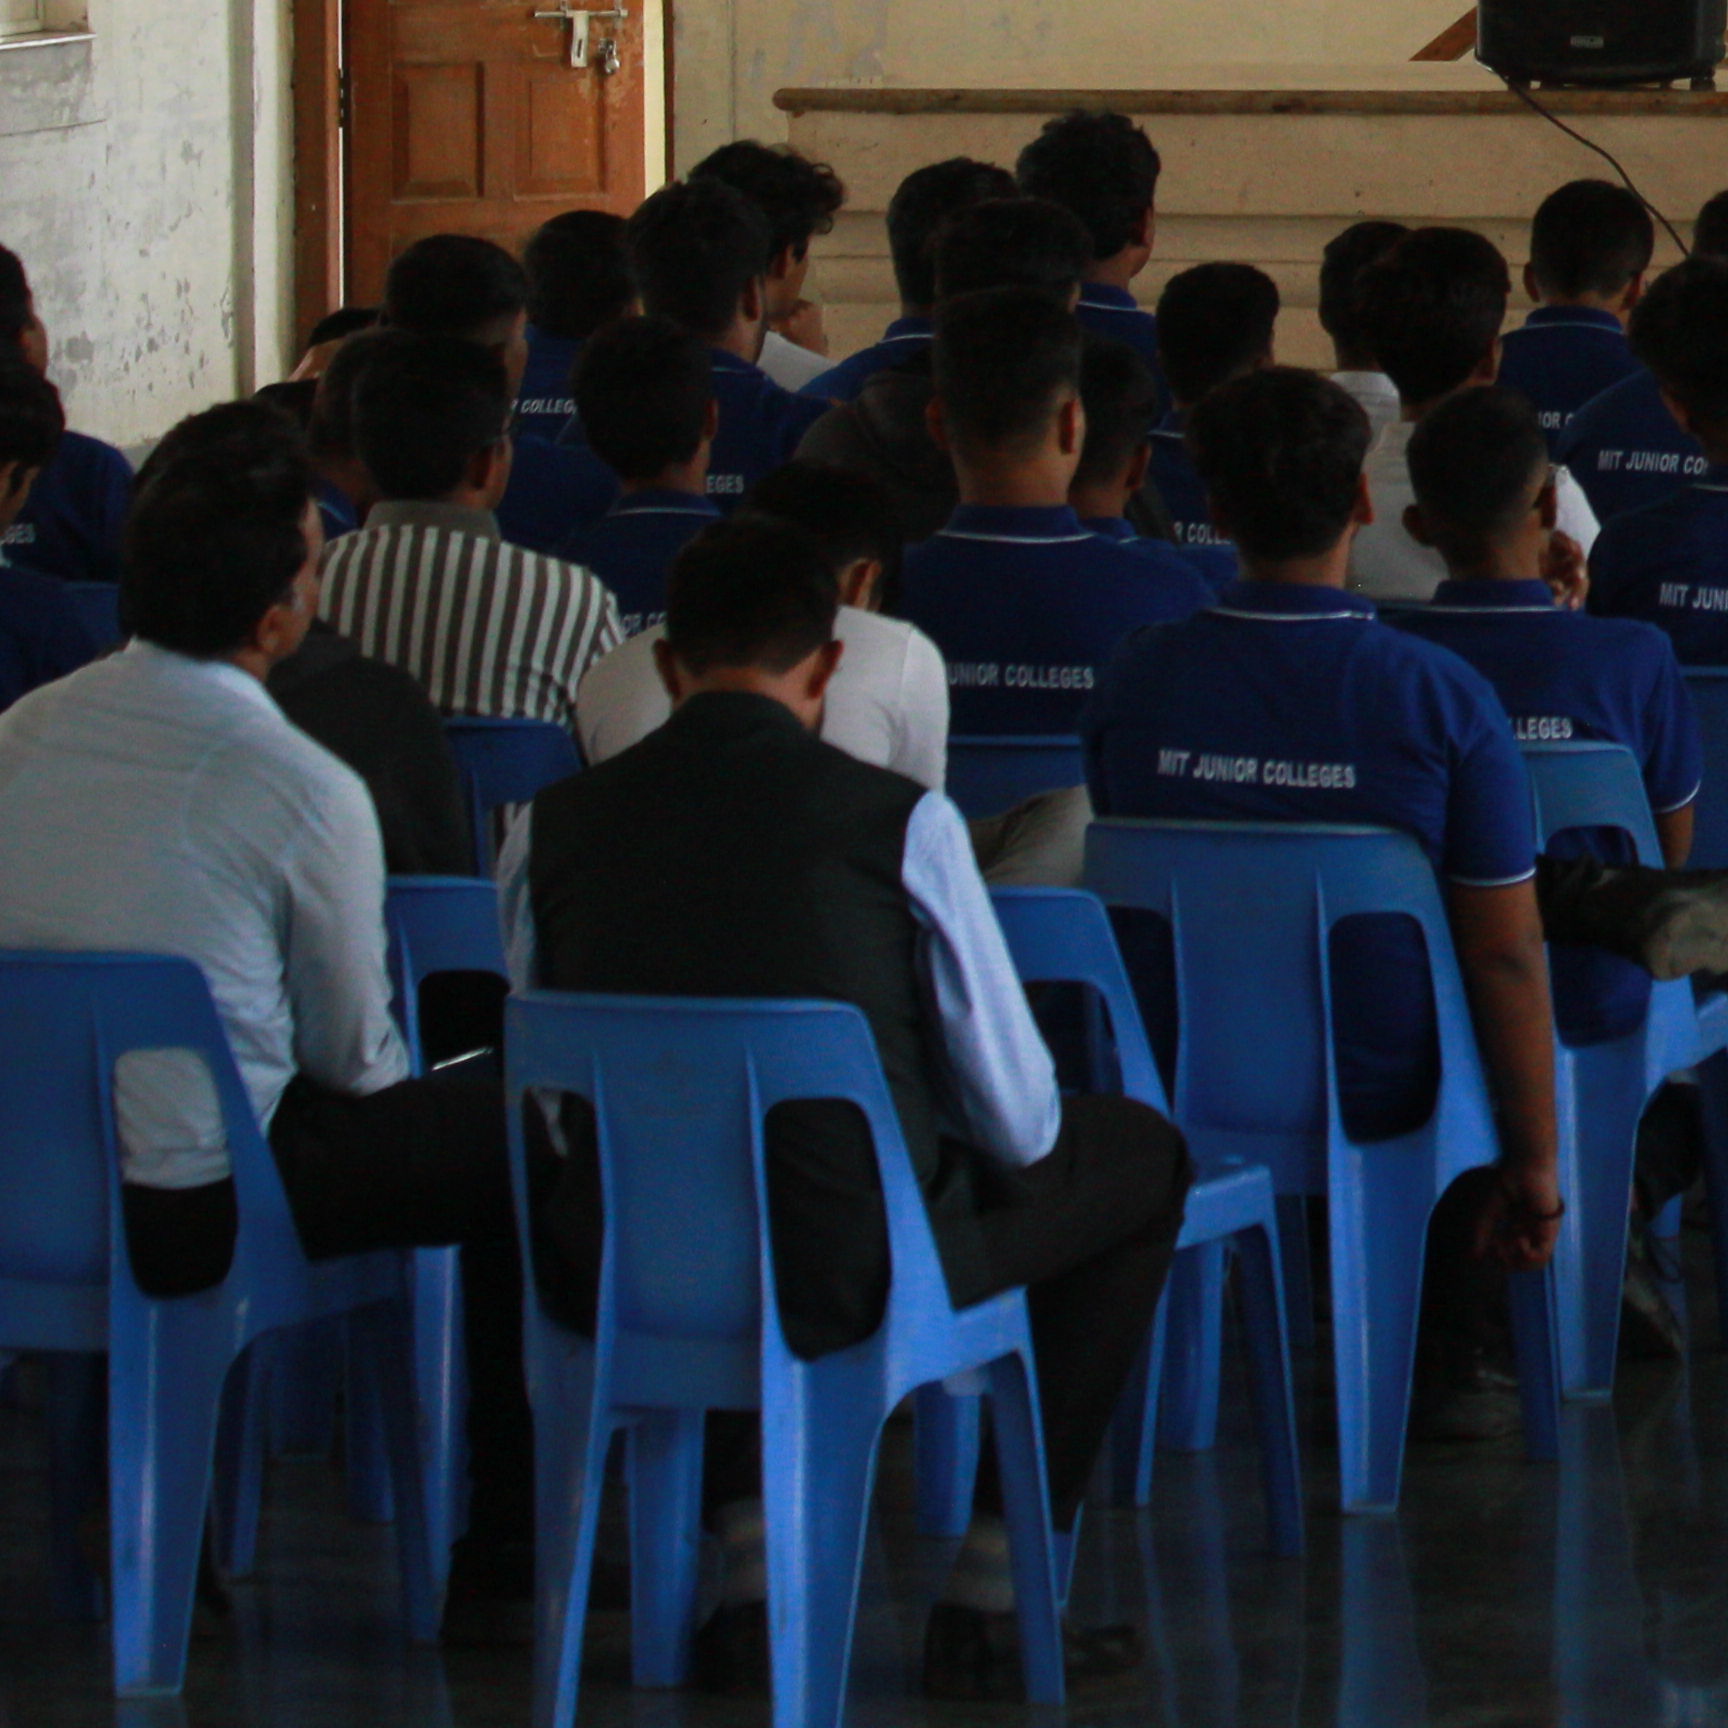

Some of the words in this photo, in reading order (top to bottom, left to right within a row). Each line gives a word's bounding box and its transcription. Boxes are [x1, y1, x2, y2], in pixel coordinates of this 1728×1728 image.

[1597, 449, 1624, 472] MIT
[1625, 450, 1680, 475] JUNIOR
[1659, 583, 1691, 608] MIT
[1004, 665, 1094, 690] COLLEGES
[1159, 748, 1192, 776] MIT
[1193, 752, 1258, 784] JUNIOR
[1262, 759, 1356, 790] COLLEGES
